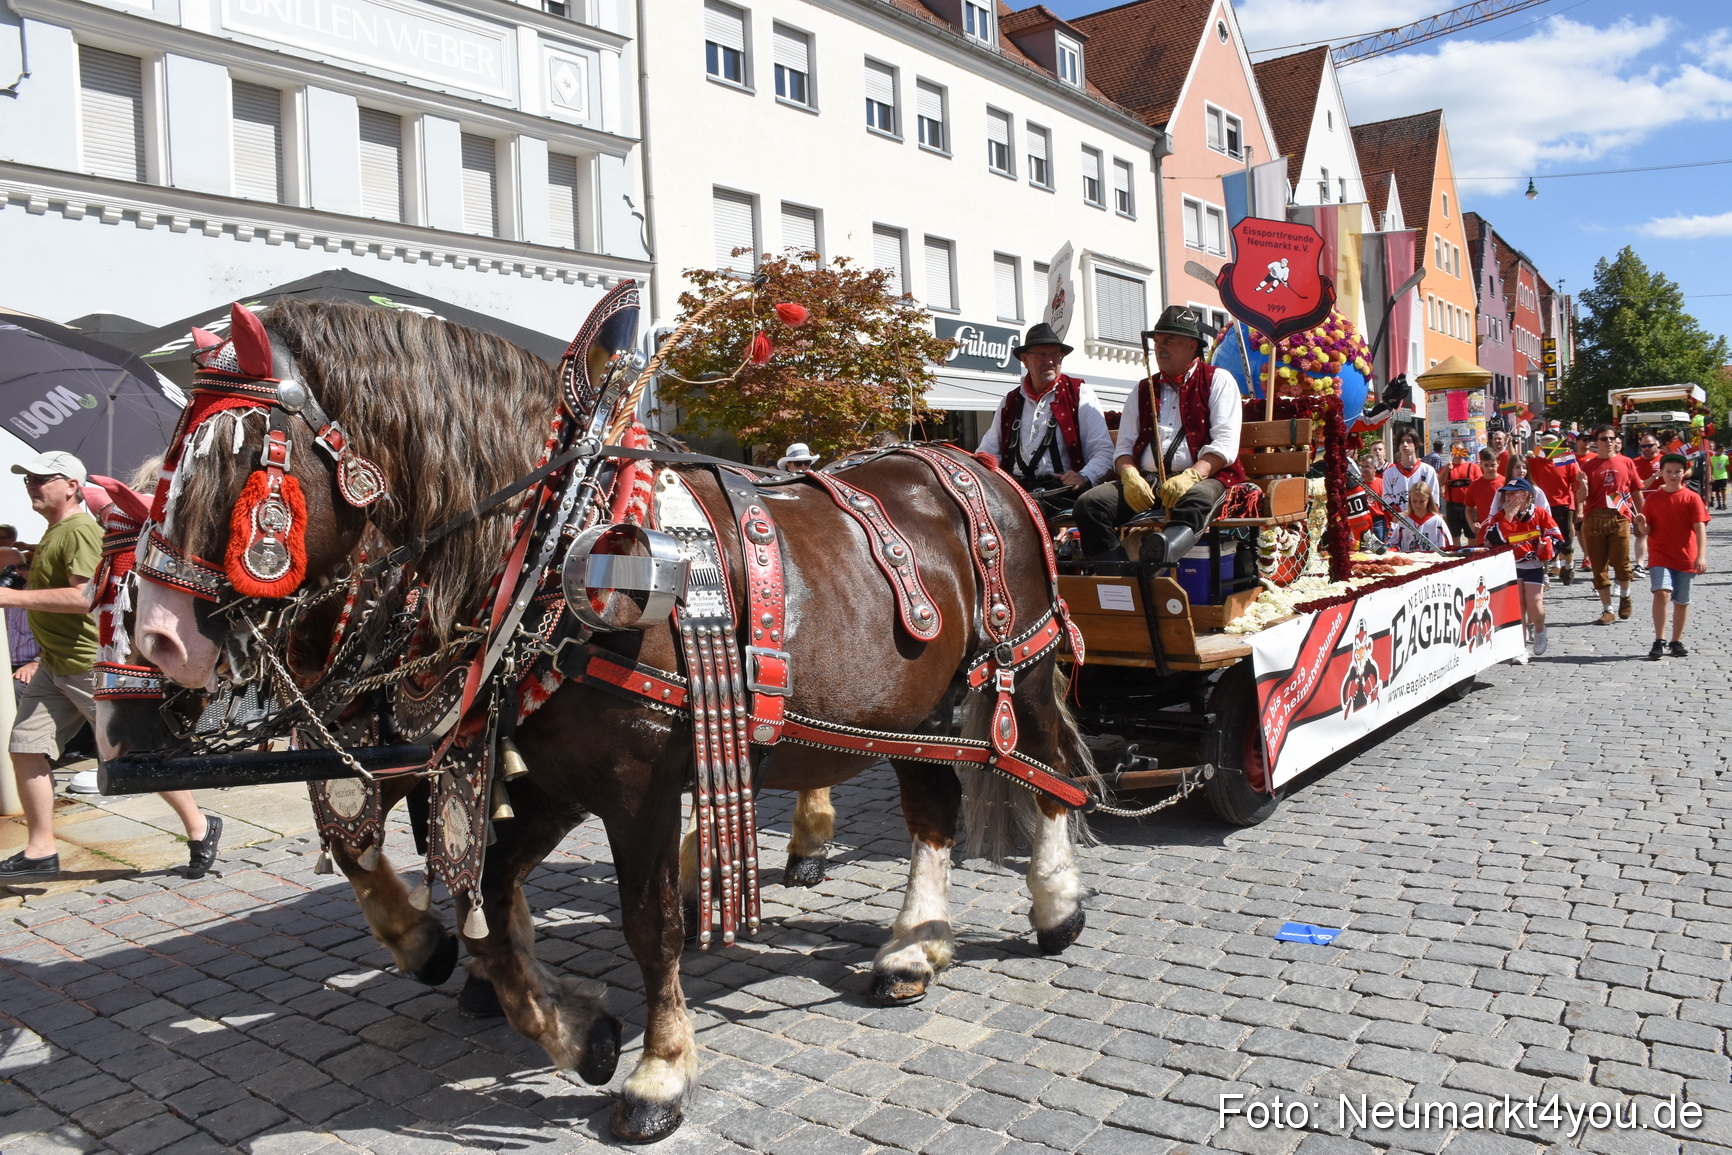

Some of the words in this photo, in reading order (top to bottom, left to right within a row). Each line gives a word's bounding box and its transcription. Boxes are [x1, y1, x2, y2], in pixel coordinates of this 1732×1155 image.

[384, 17, 497, 78] WEBER
[1242, 226, 1314, 243] Eissportfreunde
[1247, 237, 1291, 250] Neumarkt
[1267, 303, 1287, 313] 1999
[1543, 338, 1558, 405] HOTEL
[1347, 498, 1363, 513] 10
[1408, 582, 1452, 613] NEUMARKT
[1390, 587, 1464, 686] EAGLES
[1284, 612, 1343, 715] heimatverbunden
[1269, 695, 1281, 719] bis
[1283, 666, 1306, 696] 2019
